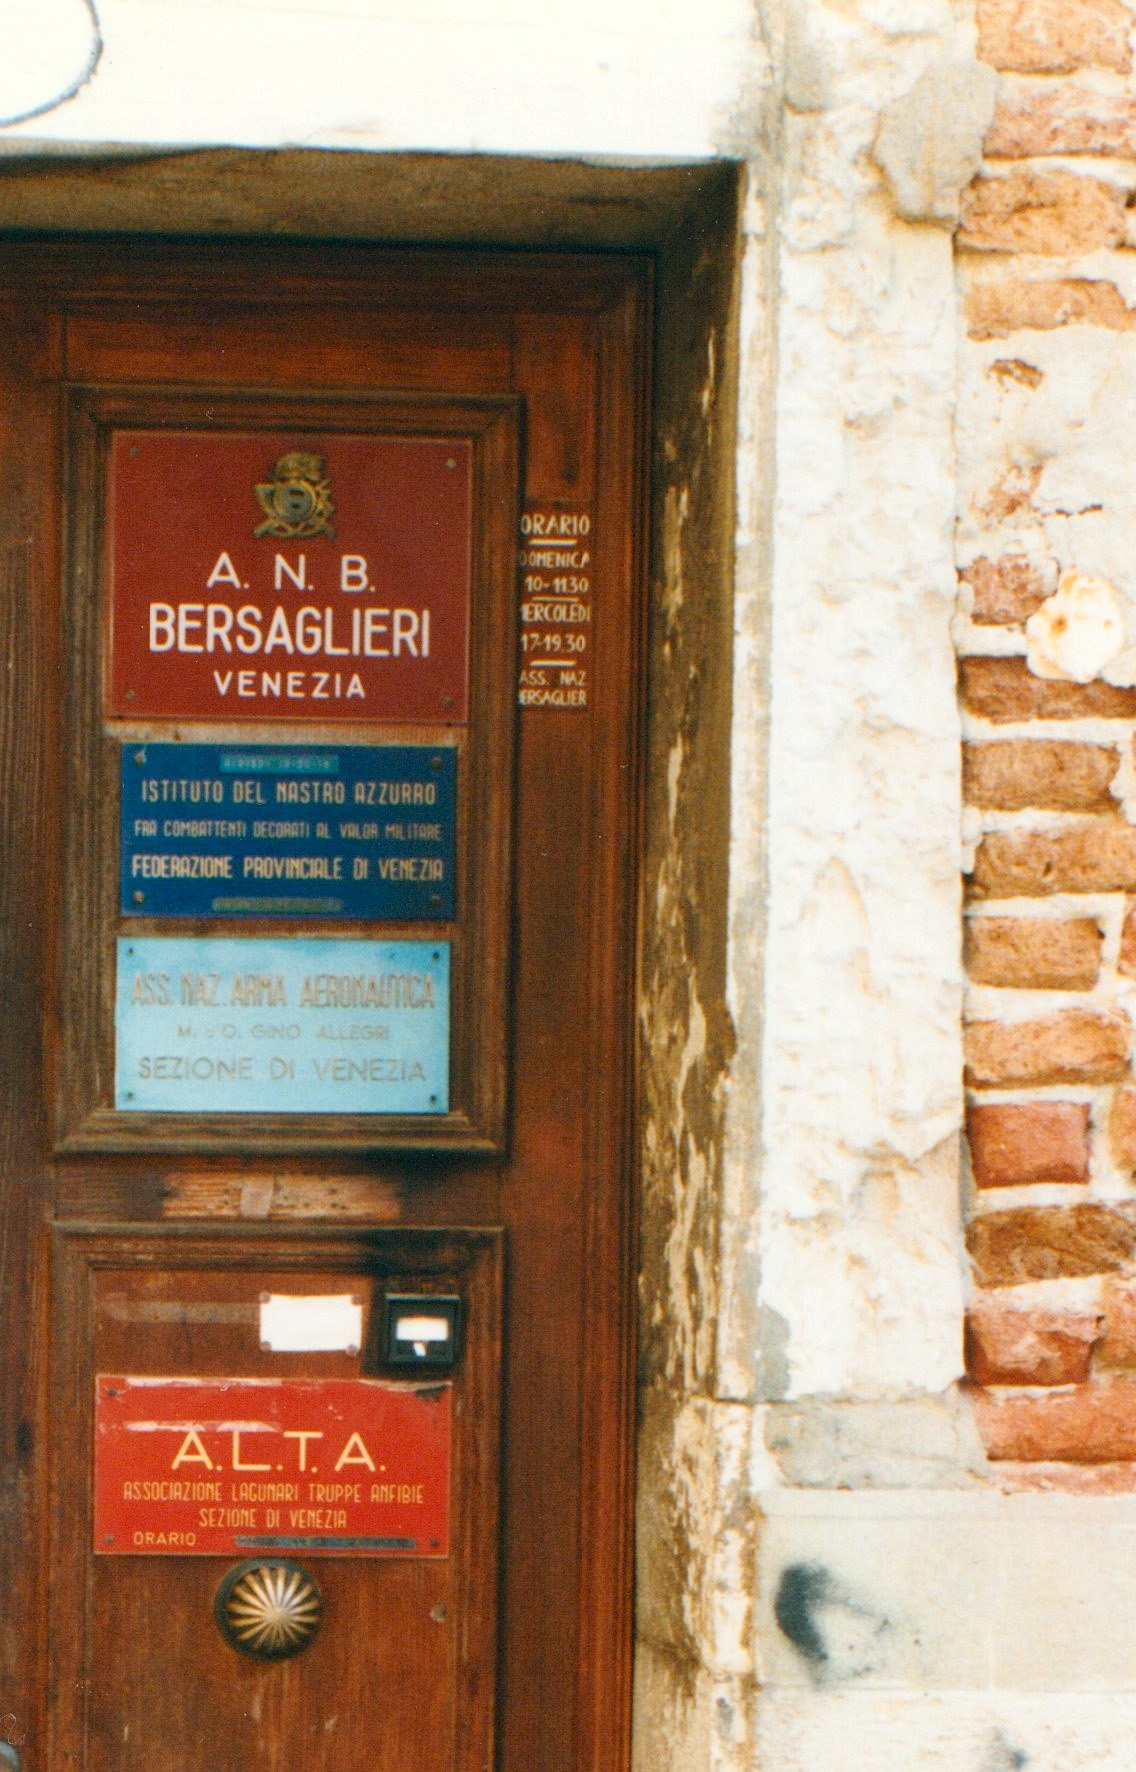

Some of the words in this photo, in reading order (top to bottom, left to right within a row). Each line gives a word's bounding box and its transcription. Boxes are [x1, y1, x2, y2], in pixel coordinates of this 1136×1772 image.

[520, 514, 590, 535] ORARIO
[149, 602, 430, 658] BERSAGLIERI
[213, 670, 366, 699] VENEZIA
[142, 779, 224, 803] ISTITUTO
[233, 781, 266, 804] DEL
[276, 781, 345, 804] NASTRO
[354, 783, 436, 805] AZZURRO
[164, 820, 246, 838] COMBATTENTI
[253, 821, 310, 839] DECORATI
[317, 822, 331, 839] AL
[340, 822, 378, 840] VALOR
[385, 823, 441, 841] MILITARE
[132, 855, 233, 879] FEDERAZIONE
[244, 857, 342, 880] PROVINCIALE
[353, 857, 368, 880] DI
[378, 858, 443, 881] VENEZIA
[180, 972, 226, 1007] NAZ.
[230, 973, 288, 1007] ARMA
[299, 973, 435, 1009] AERONAUTICA
[250, 1023, 301, 1041] GINO
[317, 1024, 391, 1042] ALLEGRI
[138, 1056, 253, 1081] SEZIONE
[268, 1057, 296, 1081] DI
[312, 1057, 426, 1083] VENEZIA
[123, 1481, 222, 1502] ASSOCIAZIONE
[232, 1482, 298, 1502] LAGUNARI
[310, 1483, 362, 1503] TRUPPE
[371, 1484, 424, 1505] ANFIBIE
[199, 1508, 258, 1528] SEZIONE
[266, 1509, 280, 1528] DI
[290, 1509, 347, 1529] VENEZIA
[134, 1531, 196, 1547] ORARIO
